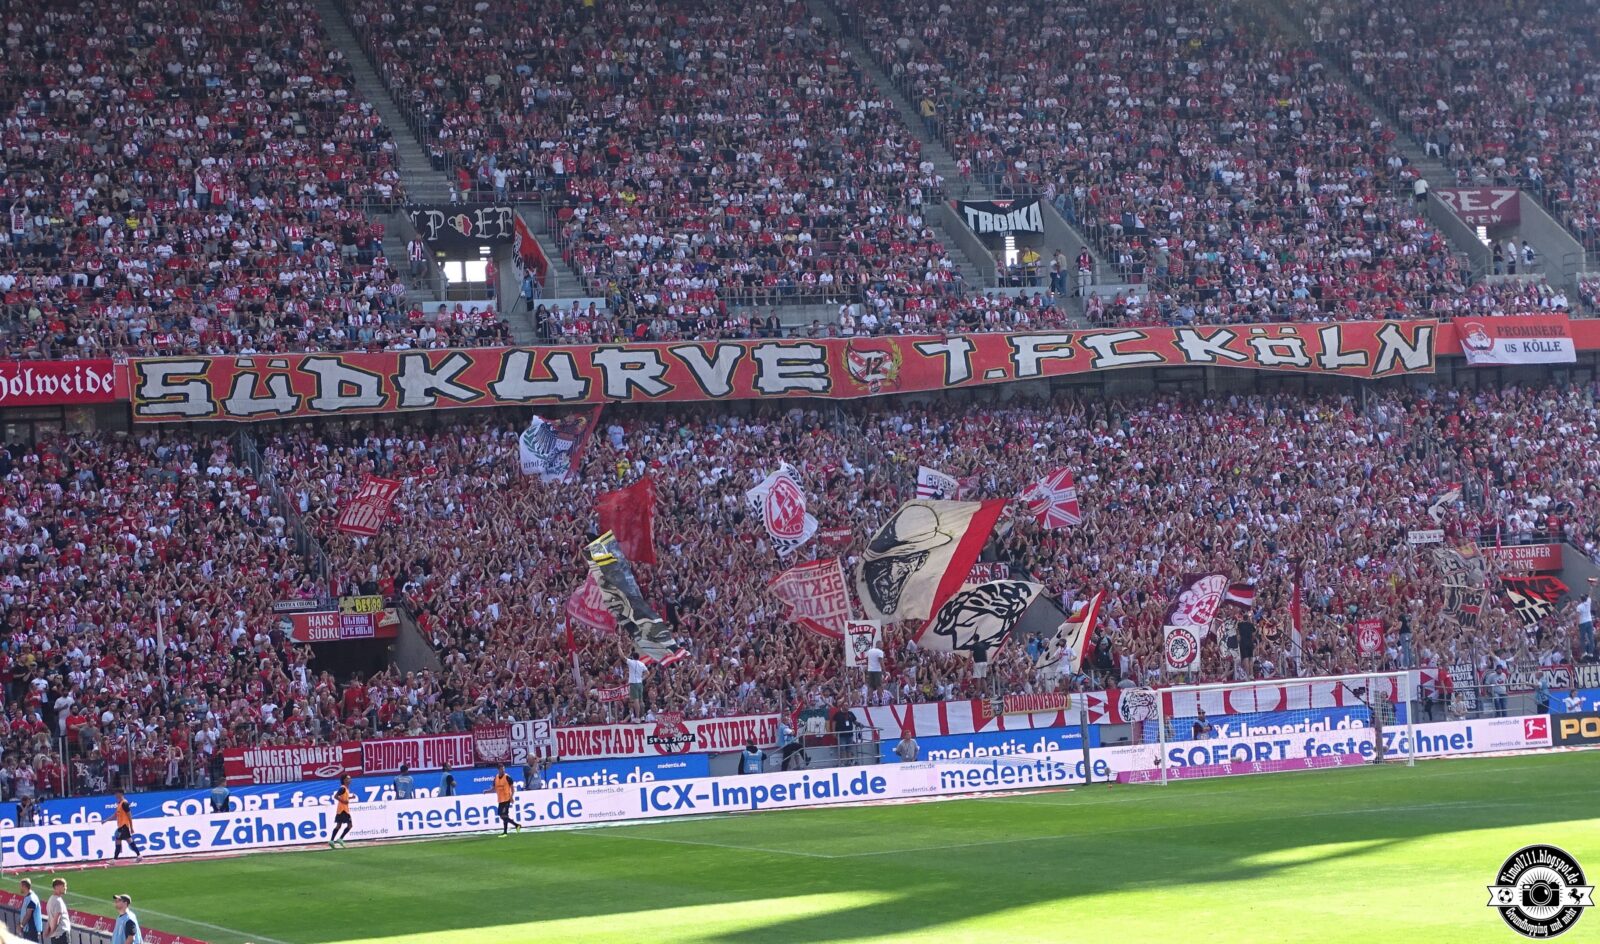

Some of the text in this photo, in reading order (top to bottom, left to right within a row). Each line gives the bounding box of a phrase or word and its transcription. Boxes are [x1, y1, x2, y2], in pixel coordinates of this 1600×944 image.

[963, 201, 1044, 234] TROIKA
[1496, 325, 1566, 337] PROMINENZ
[1504, 338, 1562, 353] US KÖLLE
[134, 341, 833, 417] SÜDKURVE
[1171, 319, 1435, 377] KÖLN
[1515, 546, 1551, 558] SCHÄFER
[308, 614, 334, 627] HANS
[1003, 692, 1068, 713] STADIONVERBOT
[697, 716, 779, 749] SYNDIKAT
[1560, 716, 1600, 740] PO
[556, 727, 645, 757] DOMSTADT
[1303, 737, 1374, 758] feste
[243, 745, 343, 768] MÜNGERSDORFER
[364, 740, 420, 772] SEMPER
[252, 765, 303, 784] STADION
[900, 763, 935, 771] medentis.de
[587, 787, 624, 796] medentis.de
[640, 770, 887, 812] ICX-Imperial.de
[901, 786, 937, 794] medentis.de
[397, 792, 583, 831] medenis.de
[588, 810, 626, 819] medentis.de
[209, 812, 328, 847] Zähne!
[349, 827, 389, 837] medentis.de
